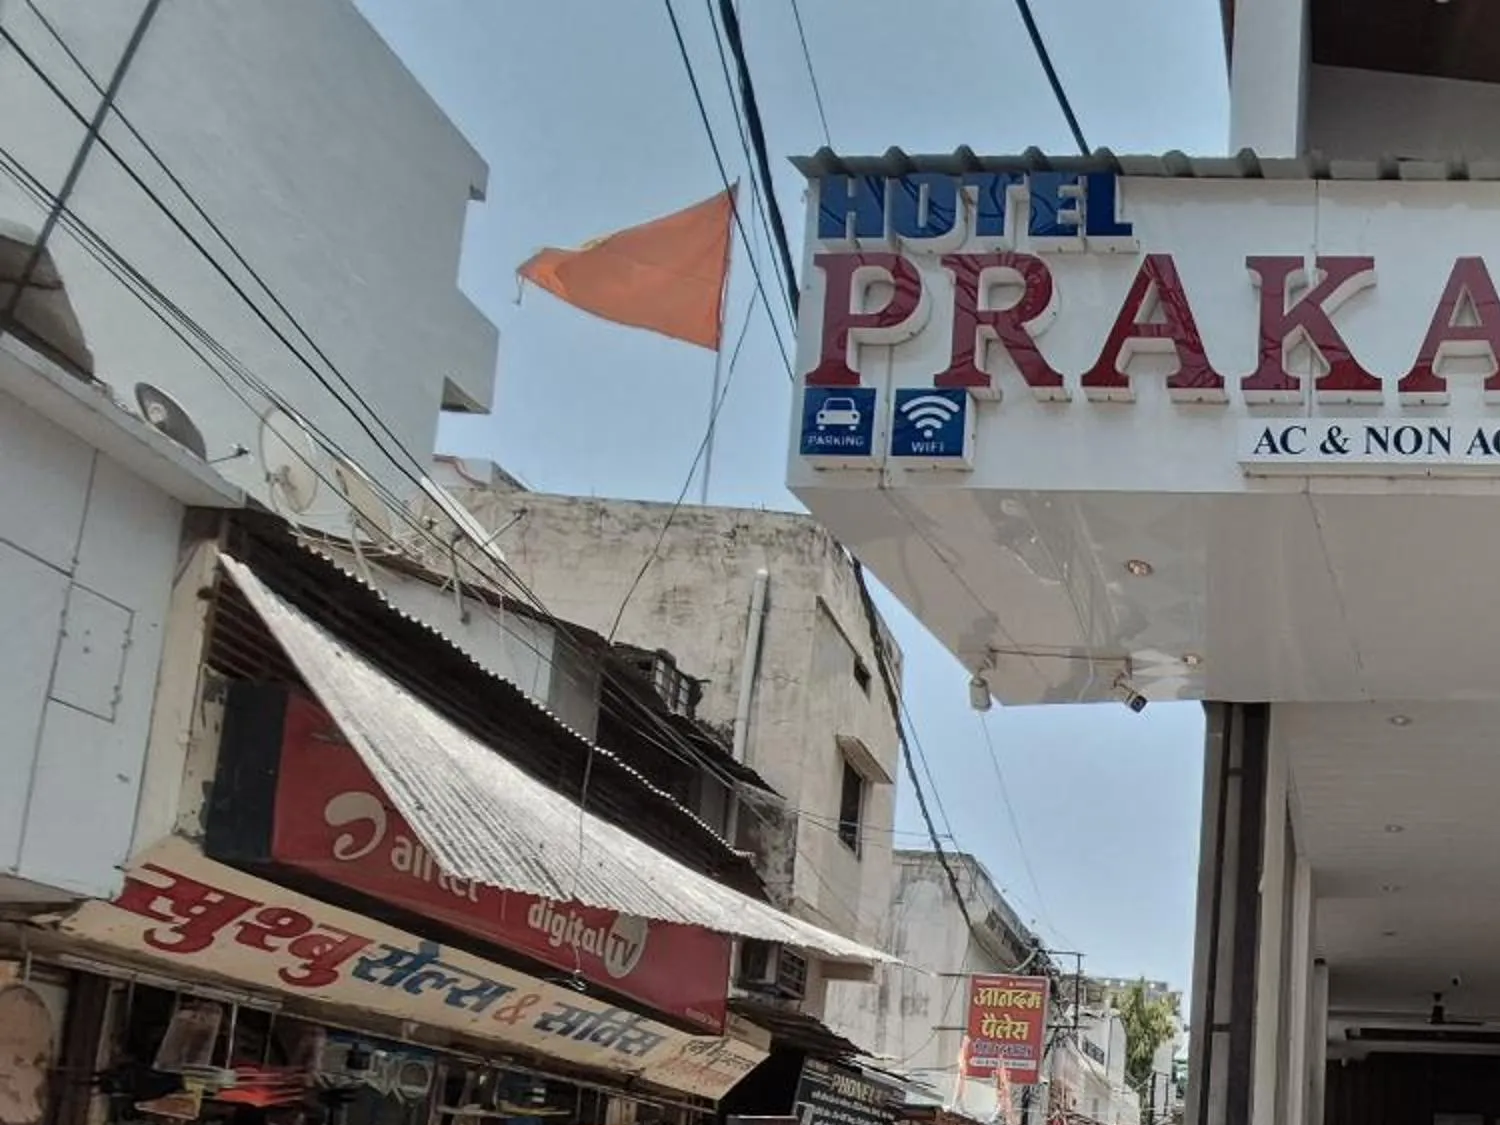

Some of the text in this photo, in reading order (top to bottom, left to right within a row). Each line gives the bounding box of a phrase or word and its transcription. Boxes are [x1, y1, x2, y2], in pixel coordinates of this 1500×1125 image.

[816, 172, 1134, 242] HOTEL
[807, 434, 864, 447] PARKING
[911, 441, 945, 453] WIFI
[1253, 425, 1307, 456] AC
[1318, 426, 1351, 456] &
[1362, 425, 1453, 456] NON
[527, 899, 640, 968] digital TV
